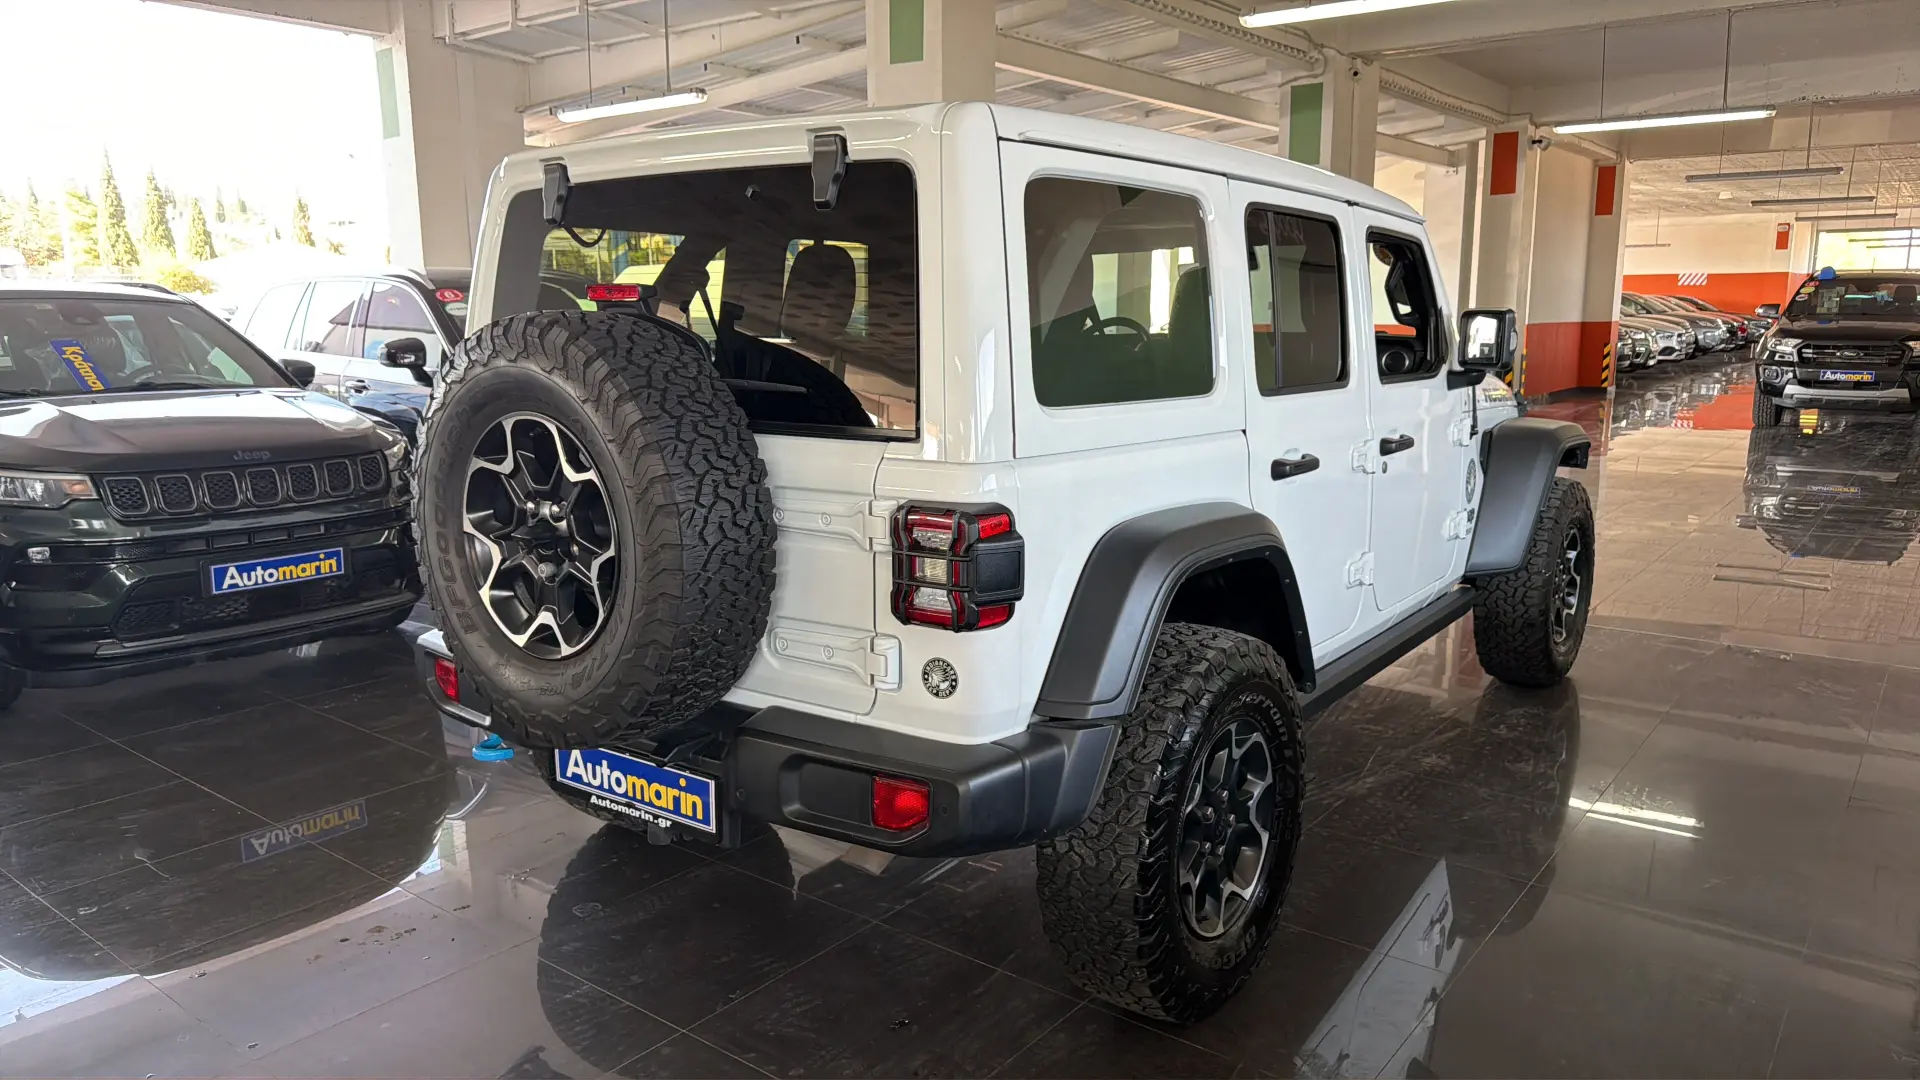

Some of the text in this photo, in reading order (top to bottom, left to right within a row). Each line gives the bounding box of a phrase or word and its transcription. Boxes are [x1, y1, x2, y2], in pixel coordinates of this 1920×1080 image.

[1823, 371, 1872, 381] Automarin
[233, 450, 271, 461] Jeep
[222, 553, 337, 589] Automarin
[566, 750, 703, 820] Automarin
[590, 795, 672, 828] Automarin.gr
